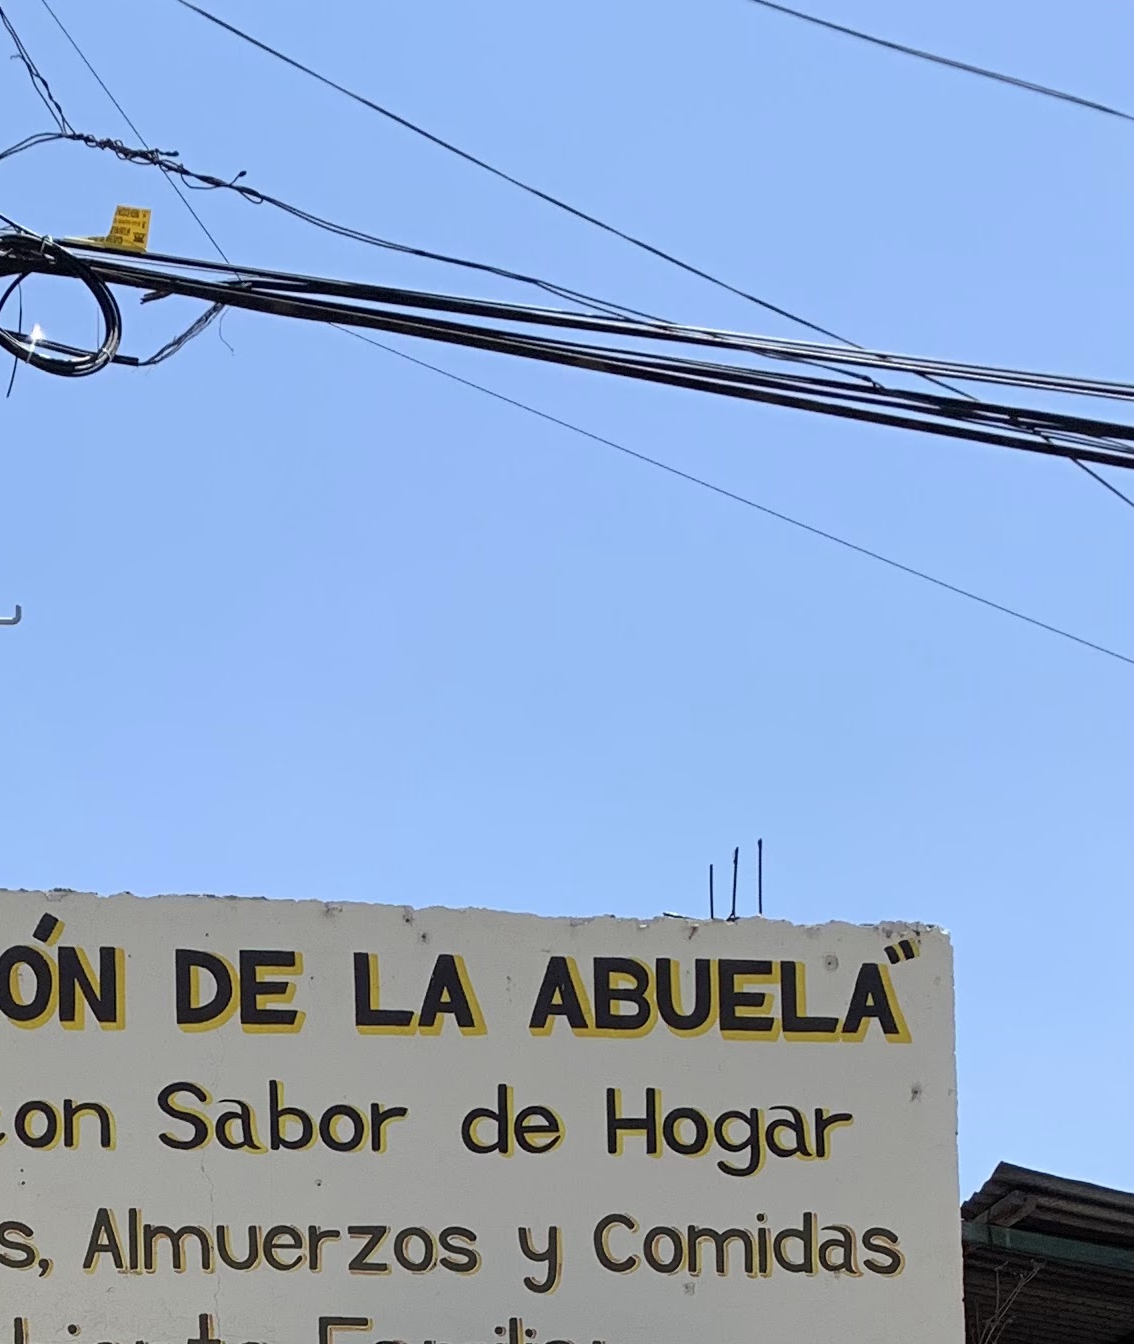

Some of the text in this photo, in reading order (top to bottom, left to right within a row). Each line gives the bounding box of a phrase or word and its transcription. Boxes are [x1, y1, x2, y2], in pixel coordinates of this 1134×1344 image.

[175, 948, 303, 1036] DE
[353, 952, 487, 1036] LA
[157, 1080, 407, 1154] Sabor
[461, 1084, 565, 1158] de
[606, 1087, 854, 1176] Hogar
[83, 1208, 481, 1275] Almuerzos
[518, 1226, 562, 1294] y
[593, 1212, 905, 1279] Comidas
